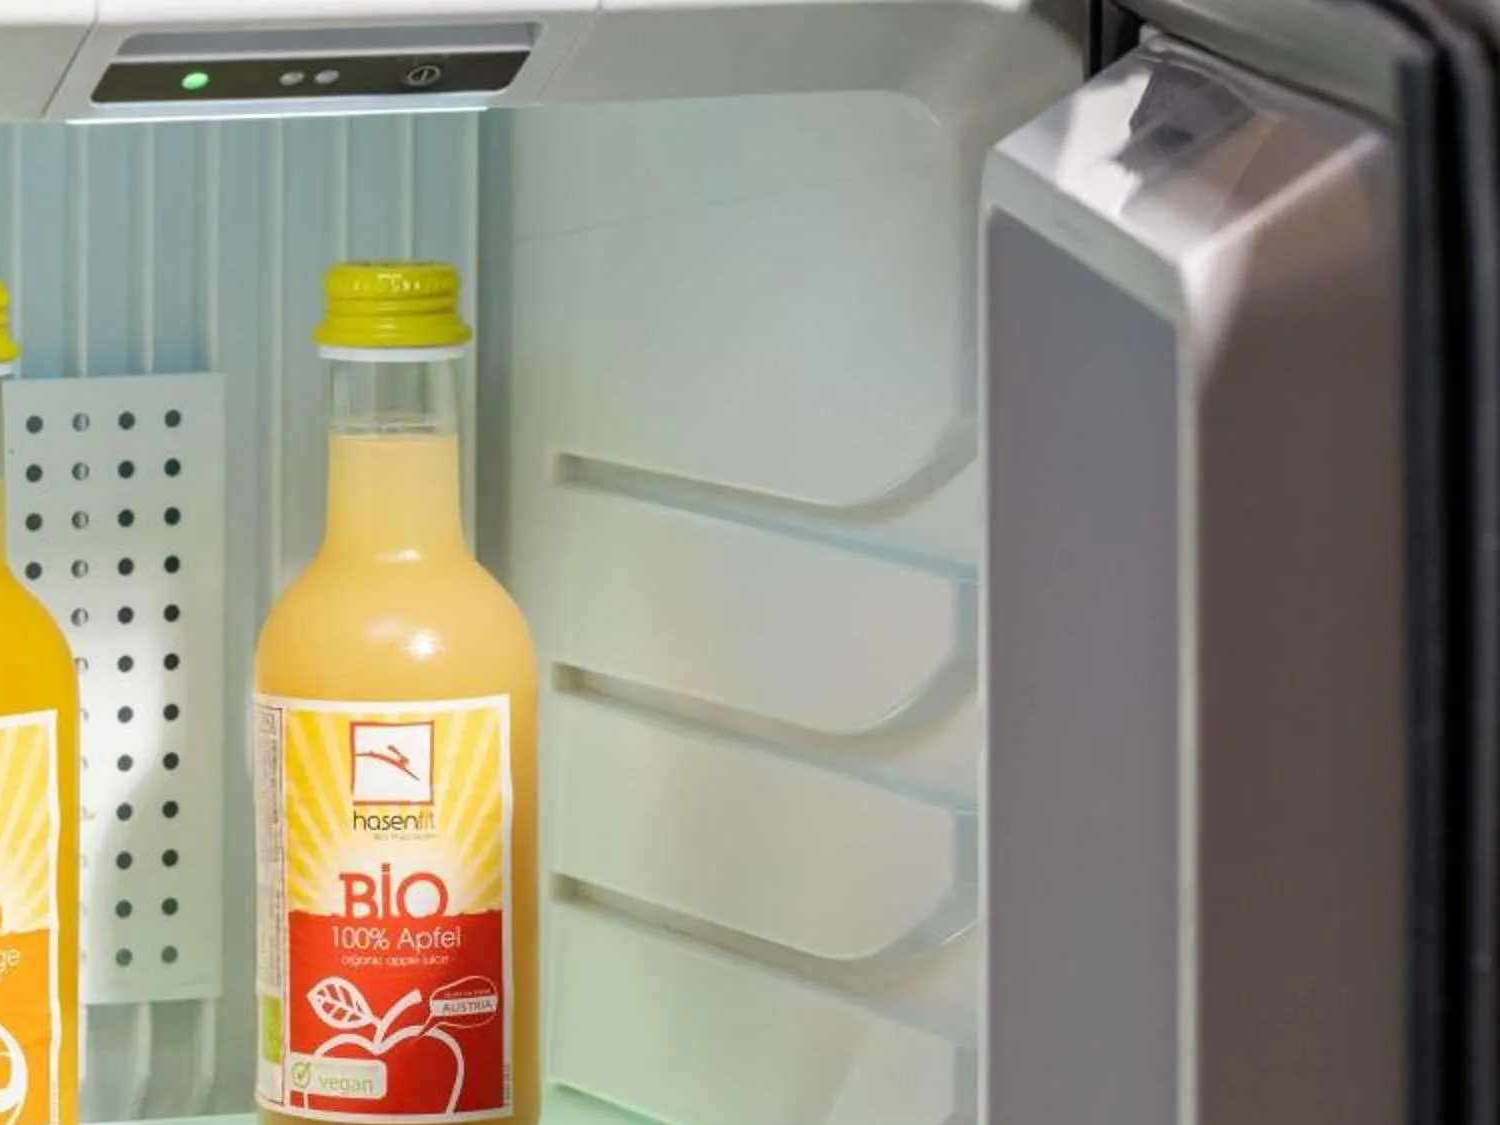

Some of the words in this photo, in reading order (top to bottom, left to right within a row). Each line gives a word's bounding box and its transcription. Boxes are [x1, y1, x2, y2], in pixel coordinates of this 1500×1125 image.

[331, 925, 390, 950] 100%
[397, 925, 462, 953] Apfel
[318, 1073, 375, 1096] vegan
